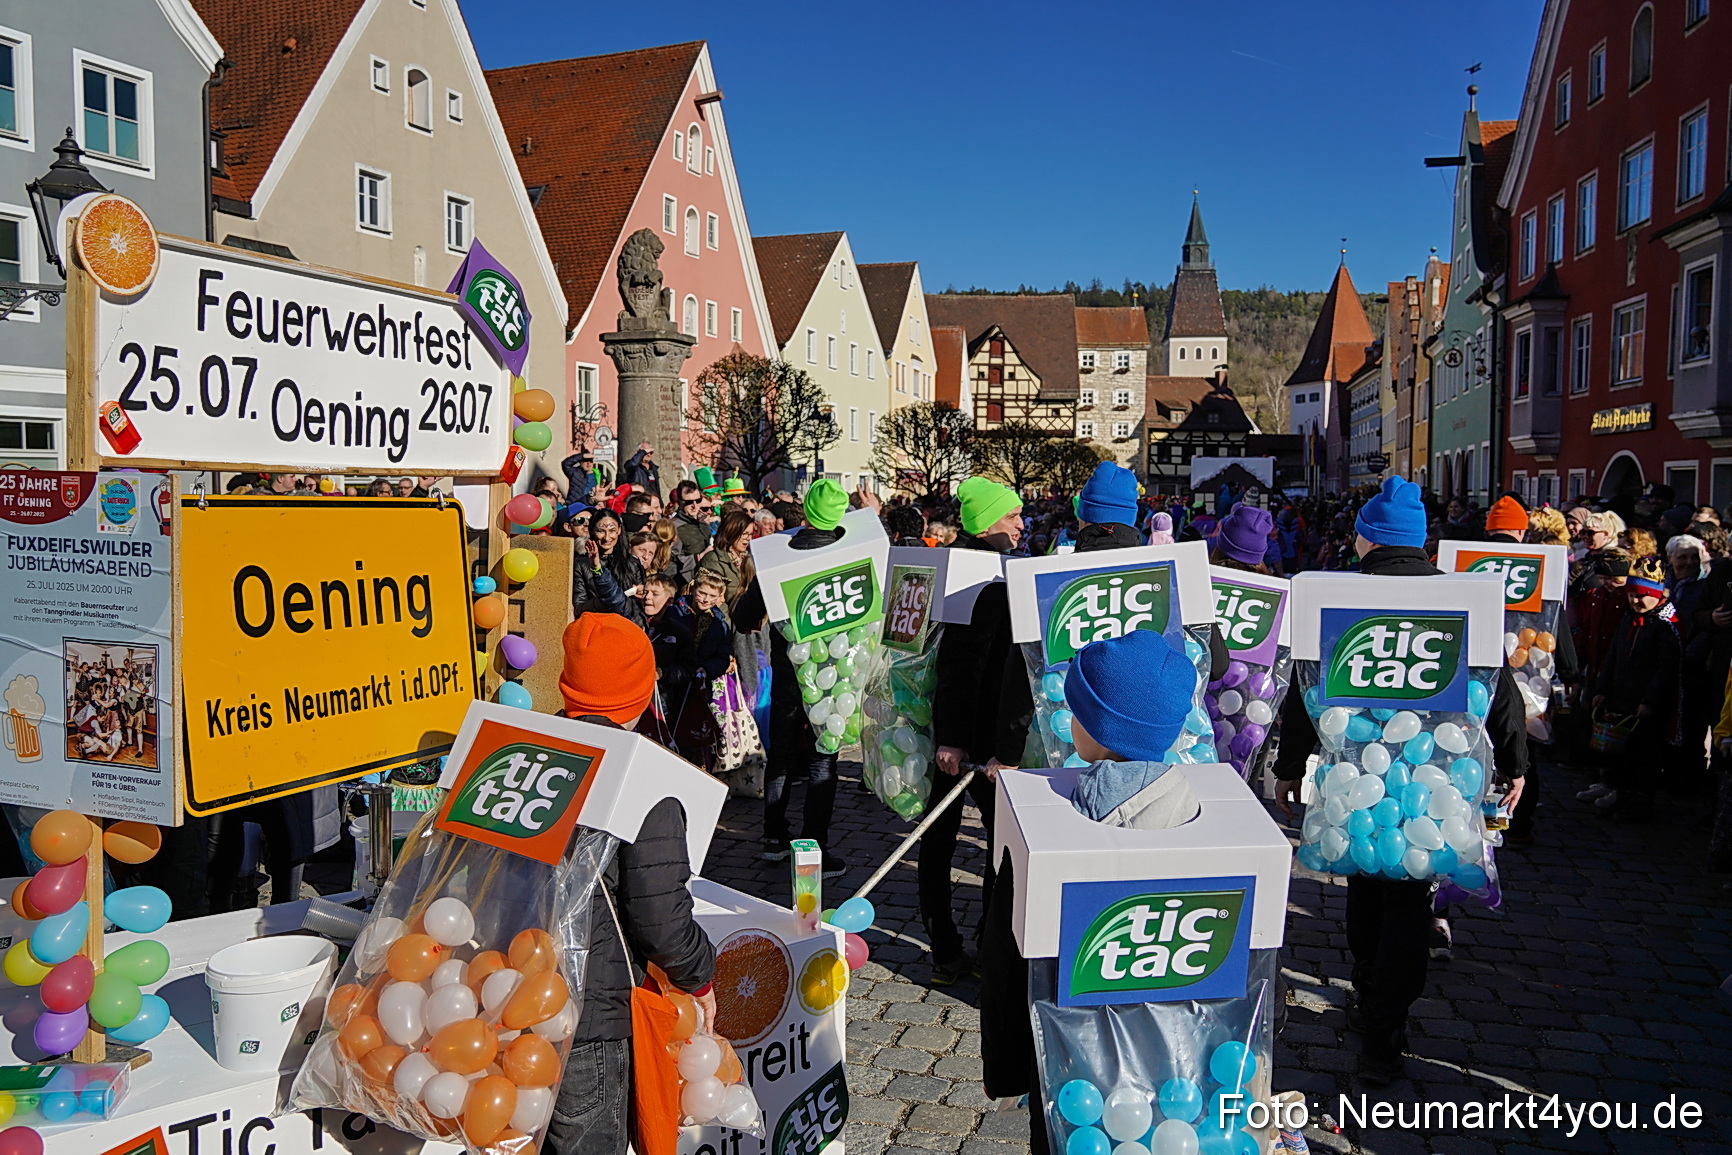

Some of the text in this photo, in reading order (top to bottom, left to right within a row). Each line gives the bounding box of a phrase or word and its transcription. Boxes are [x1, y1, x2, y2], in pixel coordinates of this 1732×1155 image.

[196, 268, 473, 370] Feuerwehrfest
[479, 287, 520, 347] tac
[118, 340, 258, 420] 25.07.
[271, 378, 410, 463] Oening
[418, 377, 493, 435] 26.07.
[0, 475, 16, 490] 25
[20, 475, 58, 492] JAHRE
[4, 494, 15, 506] FF
[7, 535, 153, 558] FUXDEIFLSWILDER
[7, 554, 152, 578] JUBILÄUMSABEND
[14, 597, 56, 607] Kabarettabend
[80, 602, 124, 612] Bauernseufzer
[27, 580, 133, 596] 25. JULI 2025 UM 20:00 UHR
[233, 560, 433, 638] Oening
[815, 575, 863, 604] tic
[900, 578, 925, 610] tic
[1083, 578, 1153, 618] tic
[42, 617, 62, 625] neuem
[63, 618, 95, 628] Programm
[44, 608, 82, 618] Tanngrindler
[83, 611, 119, 620] Musikanten
[806, 594, 865, 627] tac
[891, 605, 920, 636] tac
[1369, 621, 1444, 660] tic
[1347, 654, 1440, 690] tac
[205, 661, 464, 738] Kreis Neumarkt i.d.OPf.
[22, 782, 40, 791] Oening
[91, 772, 161, 787] KARTEN-VORVERKAUF
[91, 779, 104, 788] FÜR
[119, 783, 137, 793] ÜBER:
[502, 752, 570, 799] tic
[98, 808, 124, 818] WhatsApp
[471, 779, 554, 830] tac
[1128, 899, 1218, 945] tic
[1098, 941, 1210, 981] tac
[789, 1082, 838, 1135] tic
